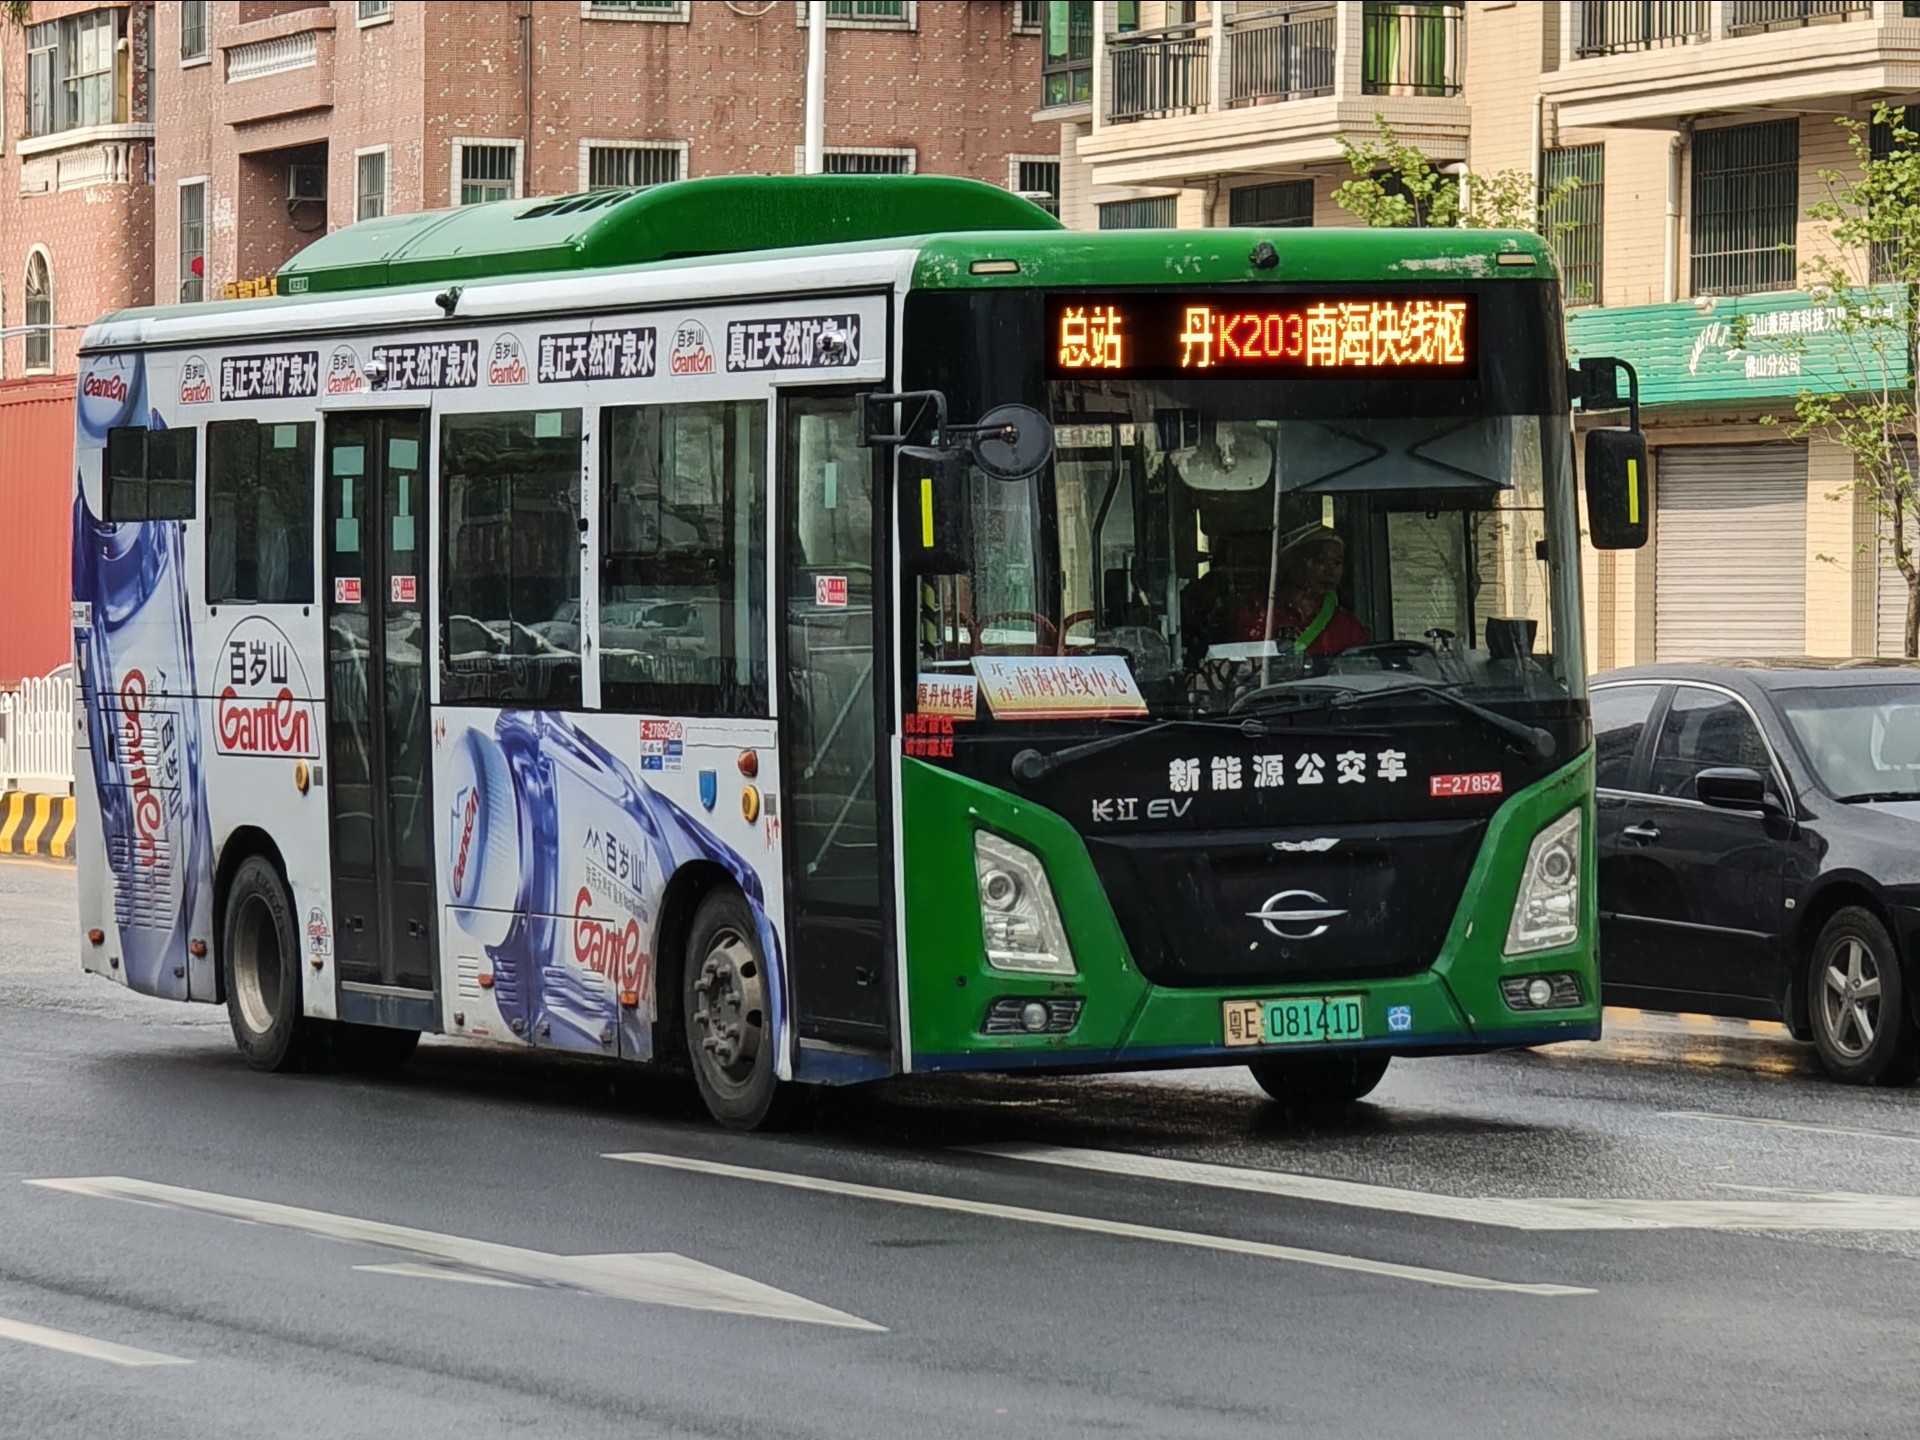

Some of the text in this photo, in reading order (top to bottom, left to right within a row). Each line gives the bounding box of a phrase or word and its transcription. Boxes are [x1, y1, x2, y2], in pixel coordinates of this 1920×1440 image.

[677, 327, 704, 346] 百岁山
[1059, 306, 1121, 368] 总站
[1218, 313, 1304, 358] K203
[1305, 300, 1467, 366] 南海快线枢
[333, 354, 354, 370] 百岁山
[495, 341, 519, 360] 百岁山
[539, 328, 654, 382] 真正天然矿泉水
[671, 346, 713, 373] Ganten
[185, 364, 205, 379] 百岁山
[221, 352, 318, 400] 真正天然矿泉水
[489, 359, 526, 383] Ganten
[1745, 352, 1801, 379] 佛山分公司
[83, 371, 127, 403] Ganten
[180, 378, 211, 402] Ganten
[327, 370, 363, 393] Ganten
[229, 640, 288, 686] 百岁山
[1013, 665, 1128, 697] 南海快线中心
[917, 683, 974, 709] 原丹灶快线
[219, 685, 309, 753] Ganten
[1169, 749, 1408, 793] 新能源公交车
[1432, 773, 1500, 794] F-27852
[1092, 797, 1193, 822] 长江 EV
[605, 831, 642, 895] 百岁山
[573, 886, 651, 1001] Ganten
[1229, 1003, 1360, 1039] 粤E 08141D
